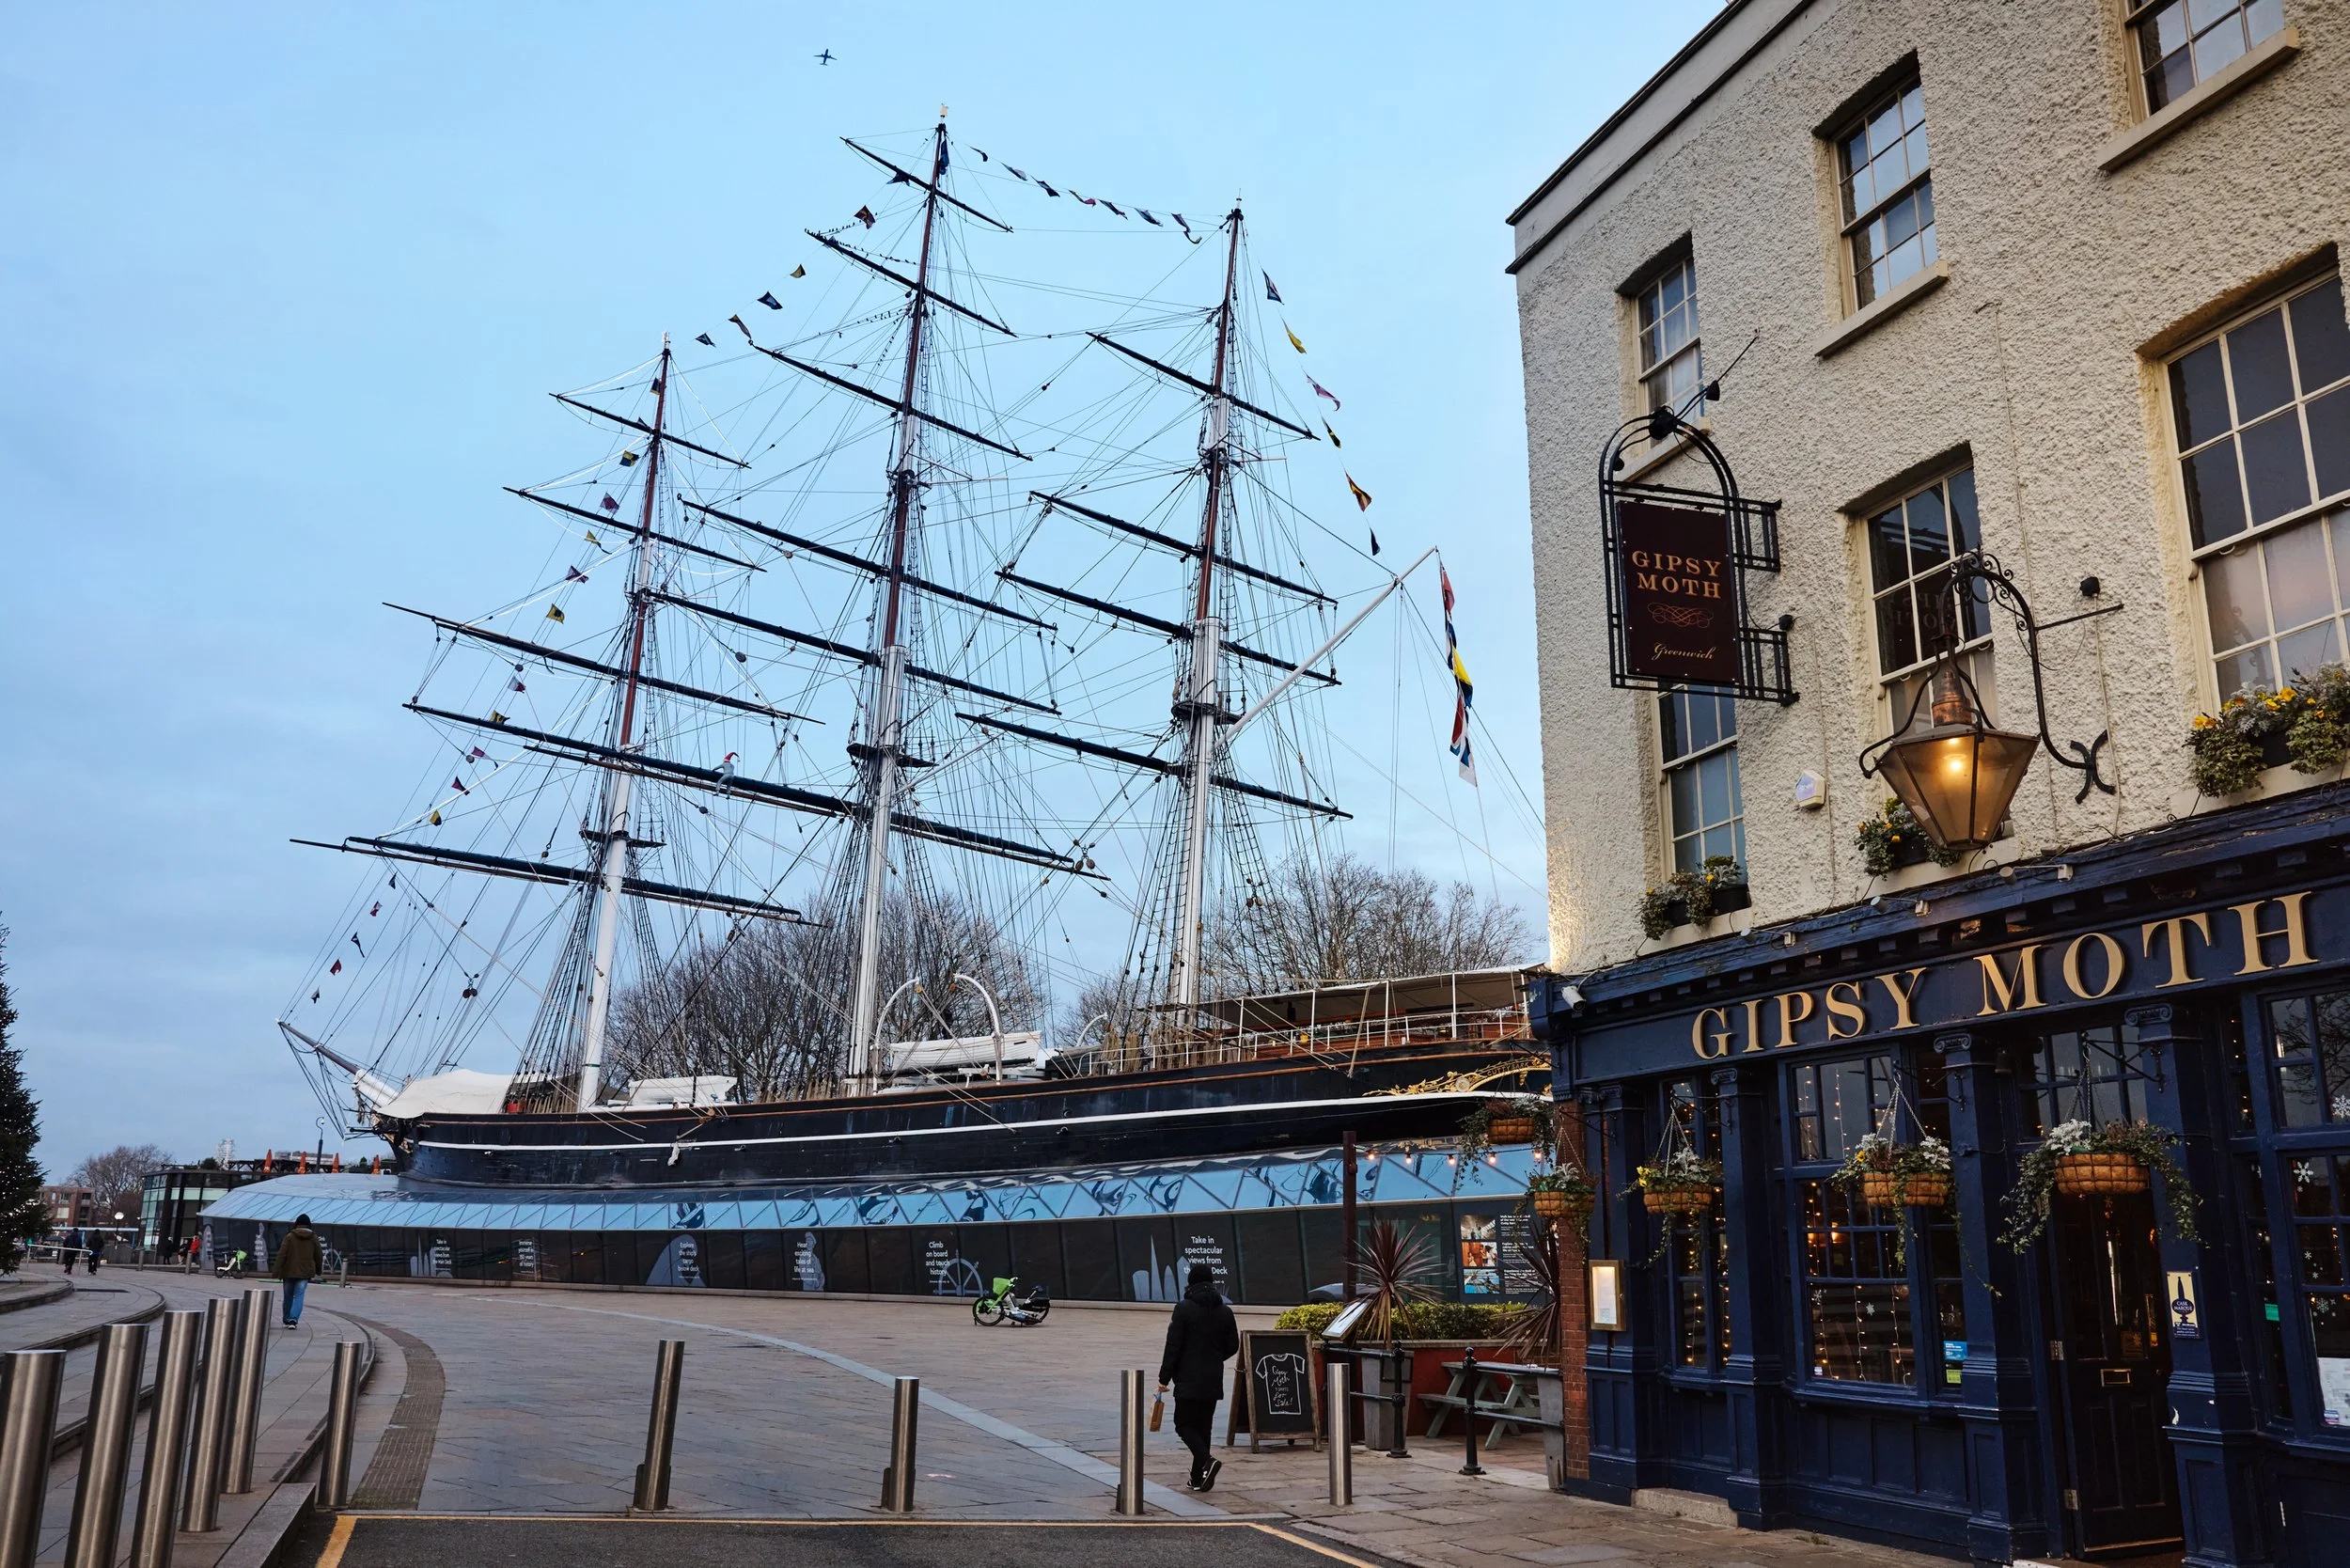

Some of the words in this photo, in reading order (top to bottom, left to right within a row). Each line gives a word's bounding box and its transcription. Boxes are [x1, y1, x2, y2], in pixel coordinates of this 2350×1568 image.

[1632, 550, 1722, 578] GIPSY
[1637, 572, 1722, 599] MOTH
[1652, 642, 1717, 662] Greenwich
[1692, 967, 1927, 1059] GIPSY
[1973, 891, 2321, 1016] MOTH
[1487, 1065, 1511, 1076] CUTTY
[1512, 1061, 1529, 1070] SARK
[1208, 1235, 1214, 1244] in
[1184, 1247, 1223, 1255] spectacular
[1188, 1256, 1206, 1264] views
[1206, 1256, 1222, 1264] from
[930, 1268, 947, 1277] history
[1211, 1266, 1228, 1275] Deck
